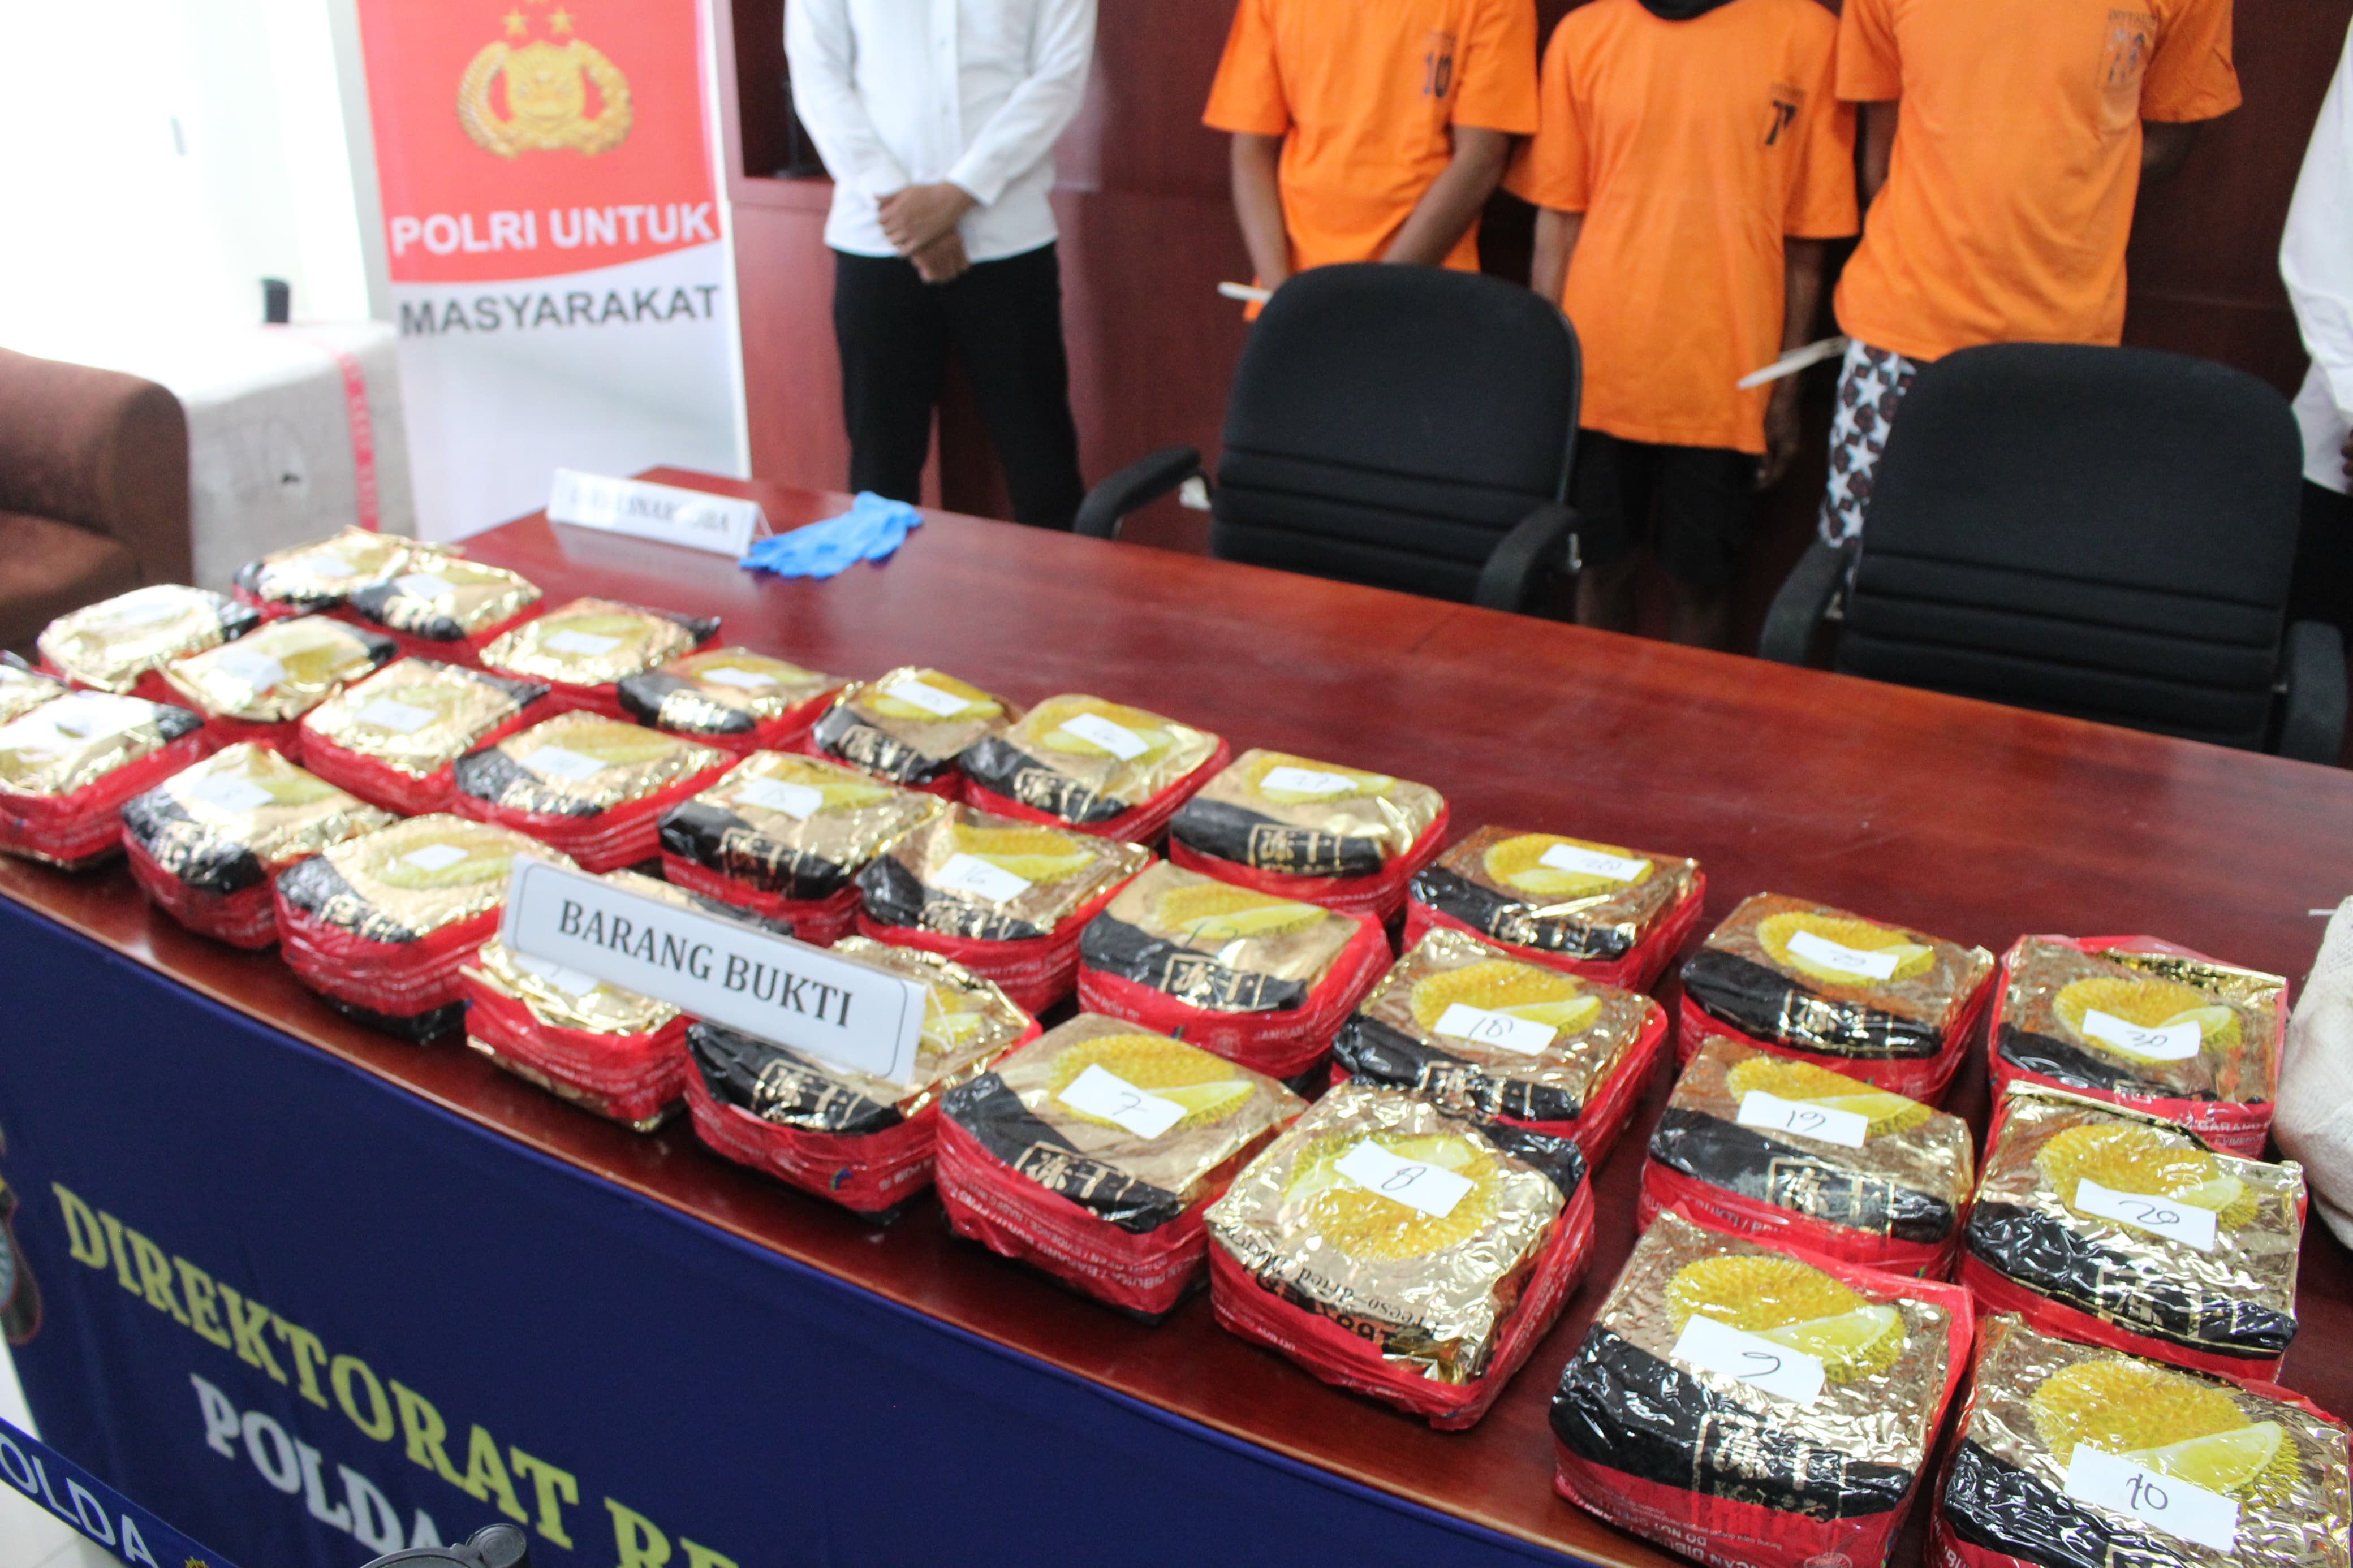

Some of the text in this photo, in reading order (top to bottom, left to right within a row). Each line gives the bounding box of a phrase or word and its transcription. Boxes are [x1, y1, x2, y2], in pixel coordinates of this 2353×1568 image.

[391, 202, 716, 256] POLRI UNTUK
[400, 286, 719, 337] MASYARAKAT
[558, 899, 854, 1029] BARANG BUKTI
[1786, 1109, 1826, 1132] 19
[52, 1181, 580, 1550] DIREKTORAT
